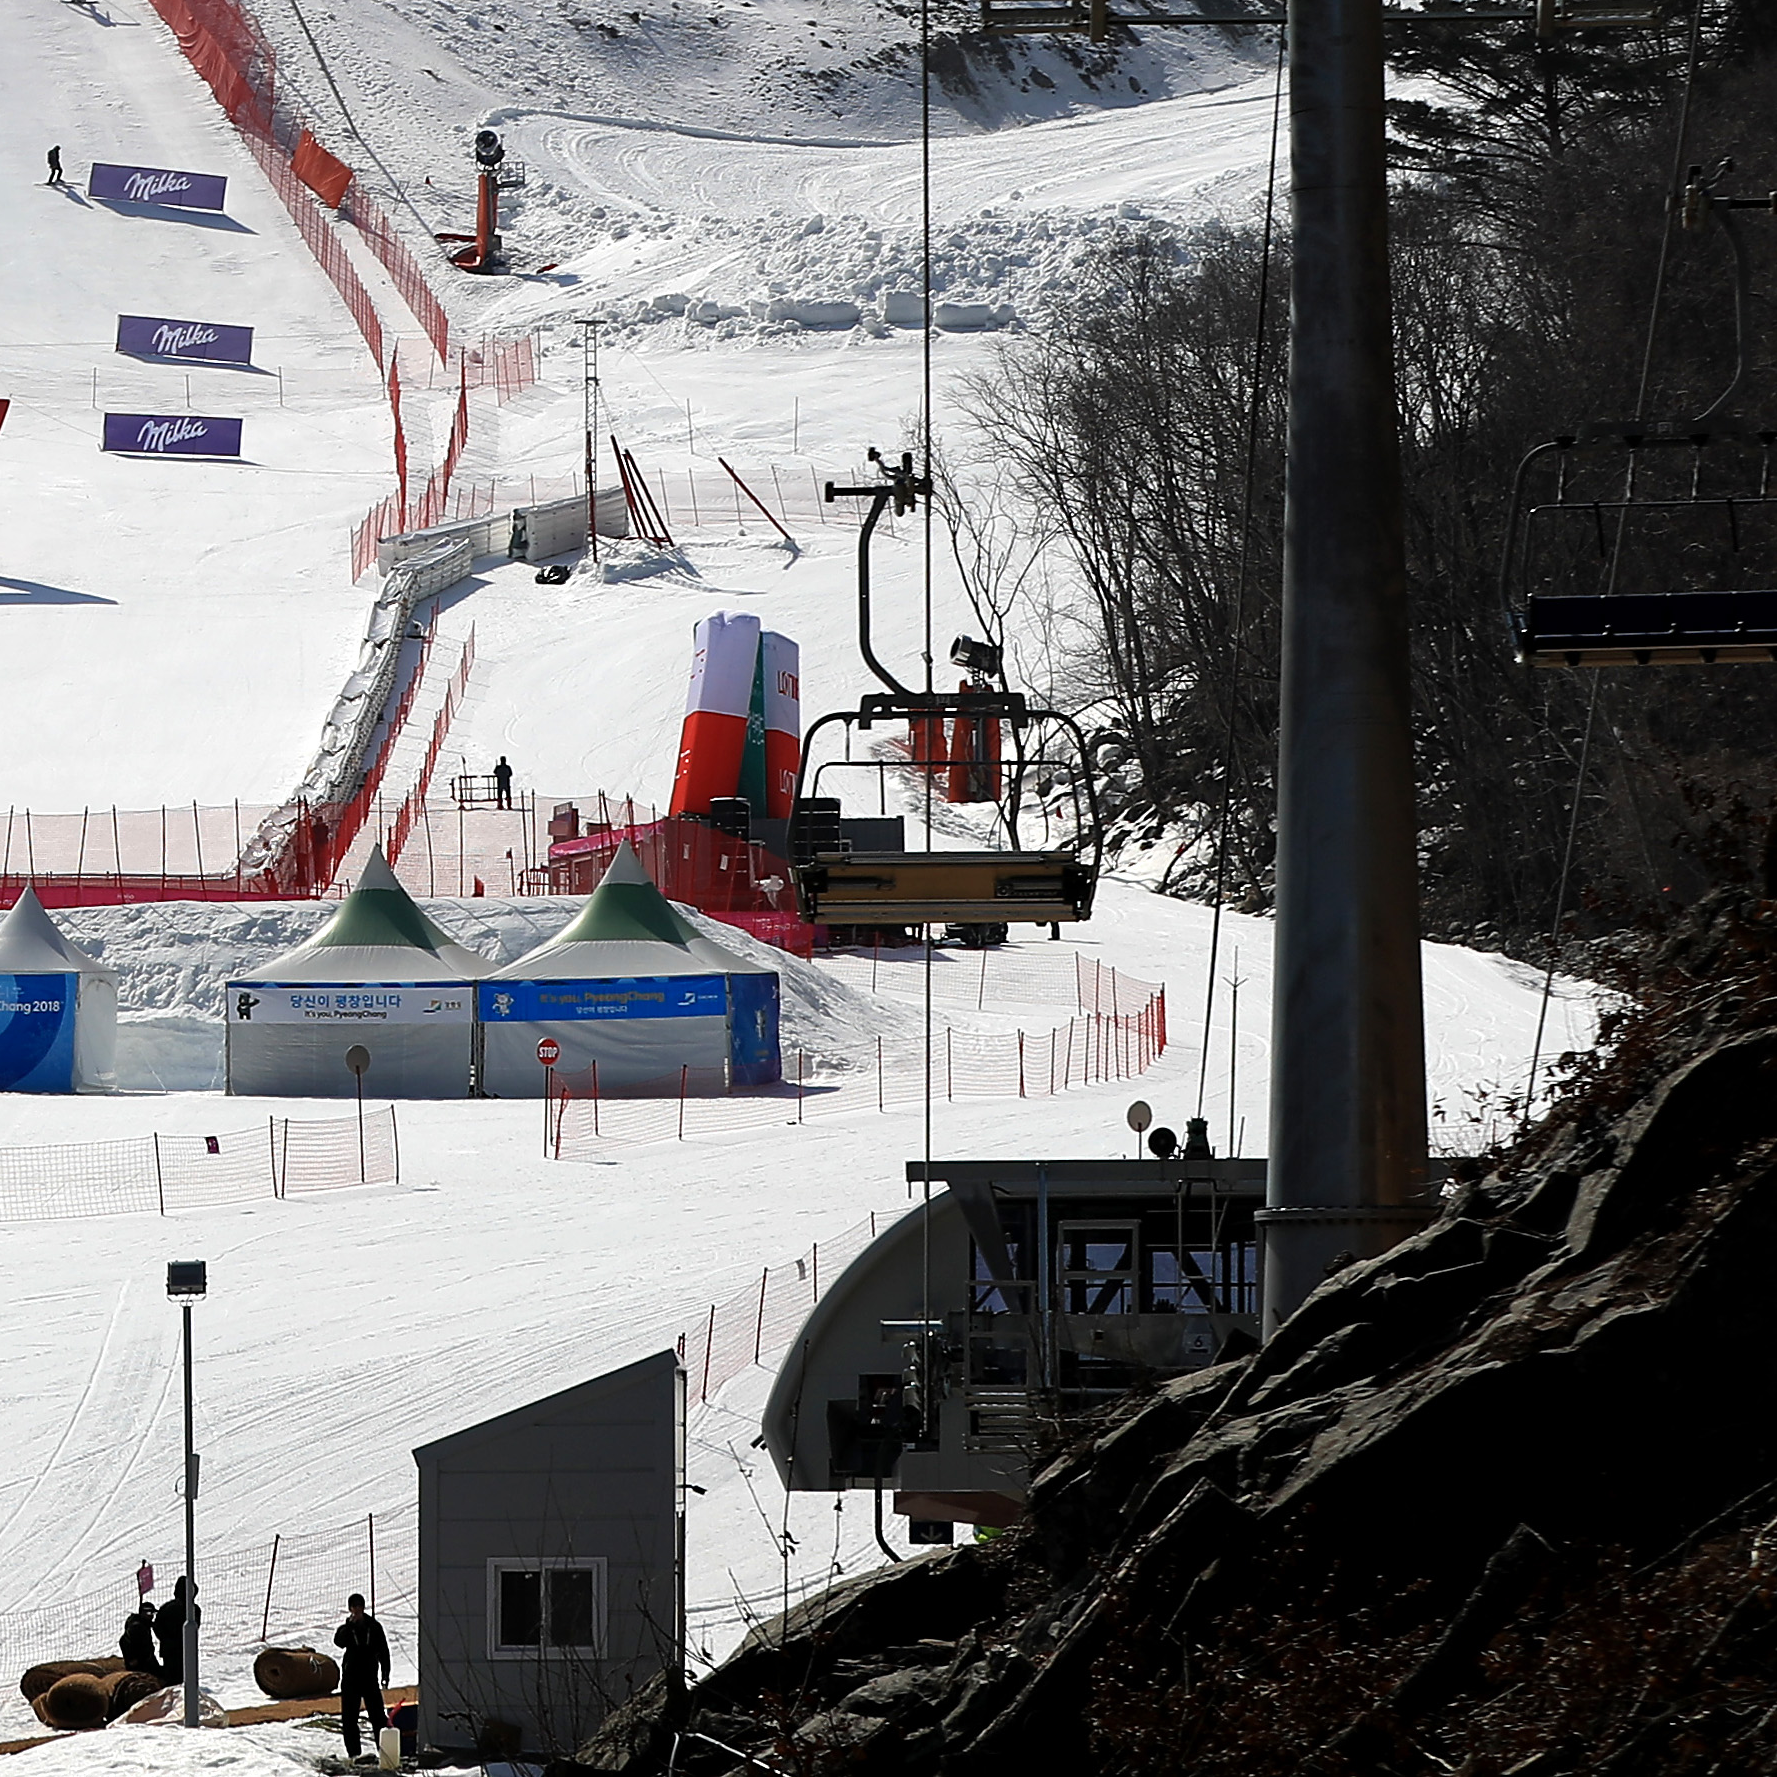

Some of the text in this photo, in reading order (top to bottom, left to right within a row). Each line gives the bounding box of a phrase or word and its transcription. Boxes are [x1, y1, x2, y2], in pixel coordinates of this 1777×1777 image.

[123, 172, 193, 201] Milka
[151, 323, 220, 354] Milka
[137, 417, 210, 452] Milka
[32, 1000, 60, 1012] 2018
[290, 994, 402, 1009] 당신이 평창입니다
[304, 1010, 387, 1020] It's you, PyeongChang
[538, 1046, 558, 1058] STOP
